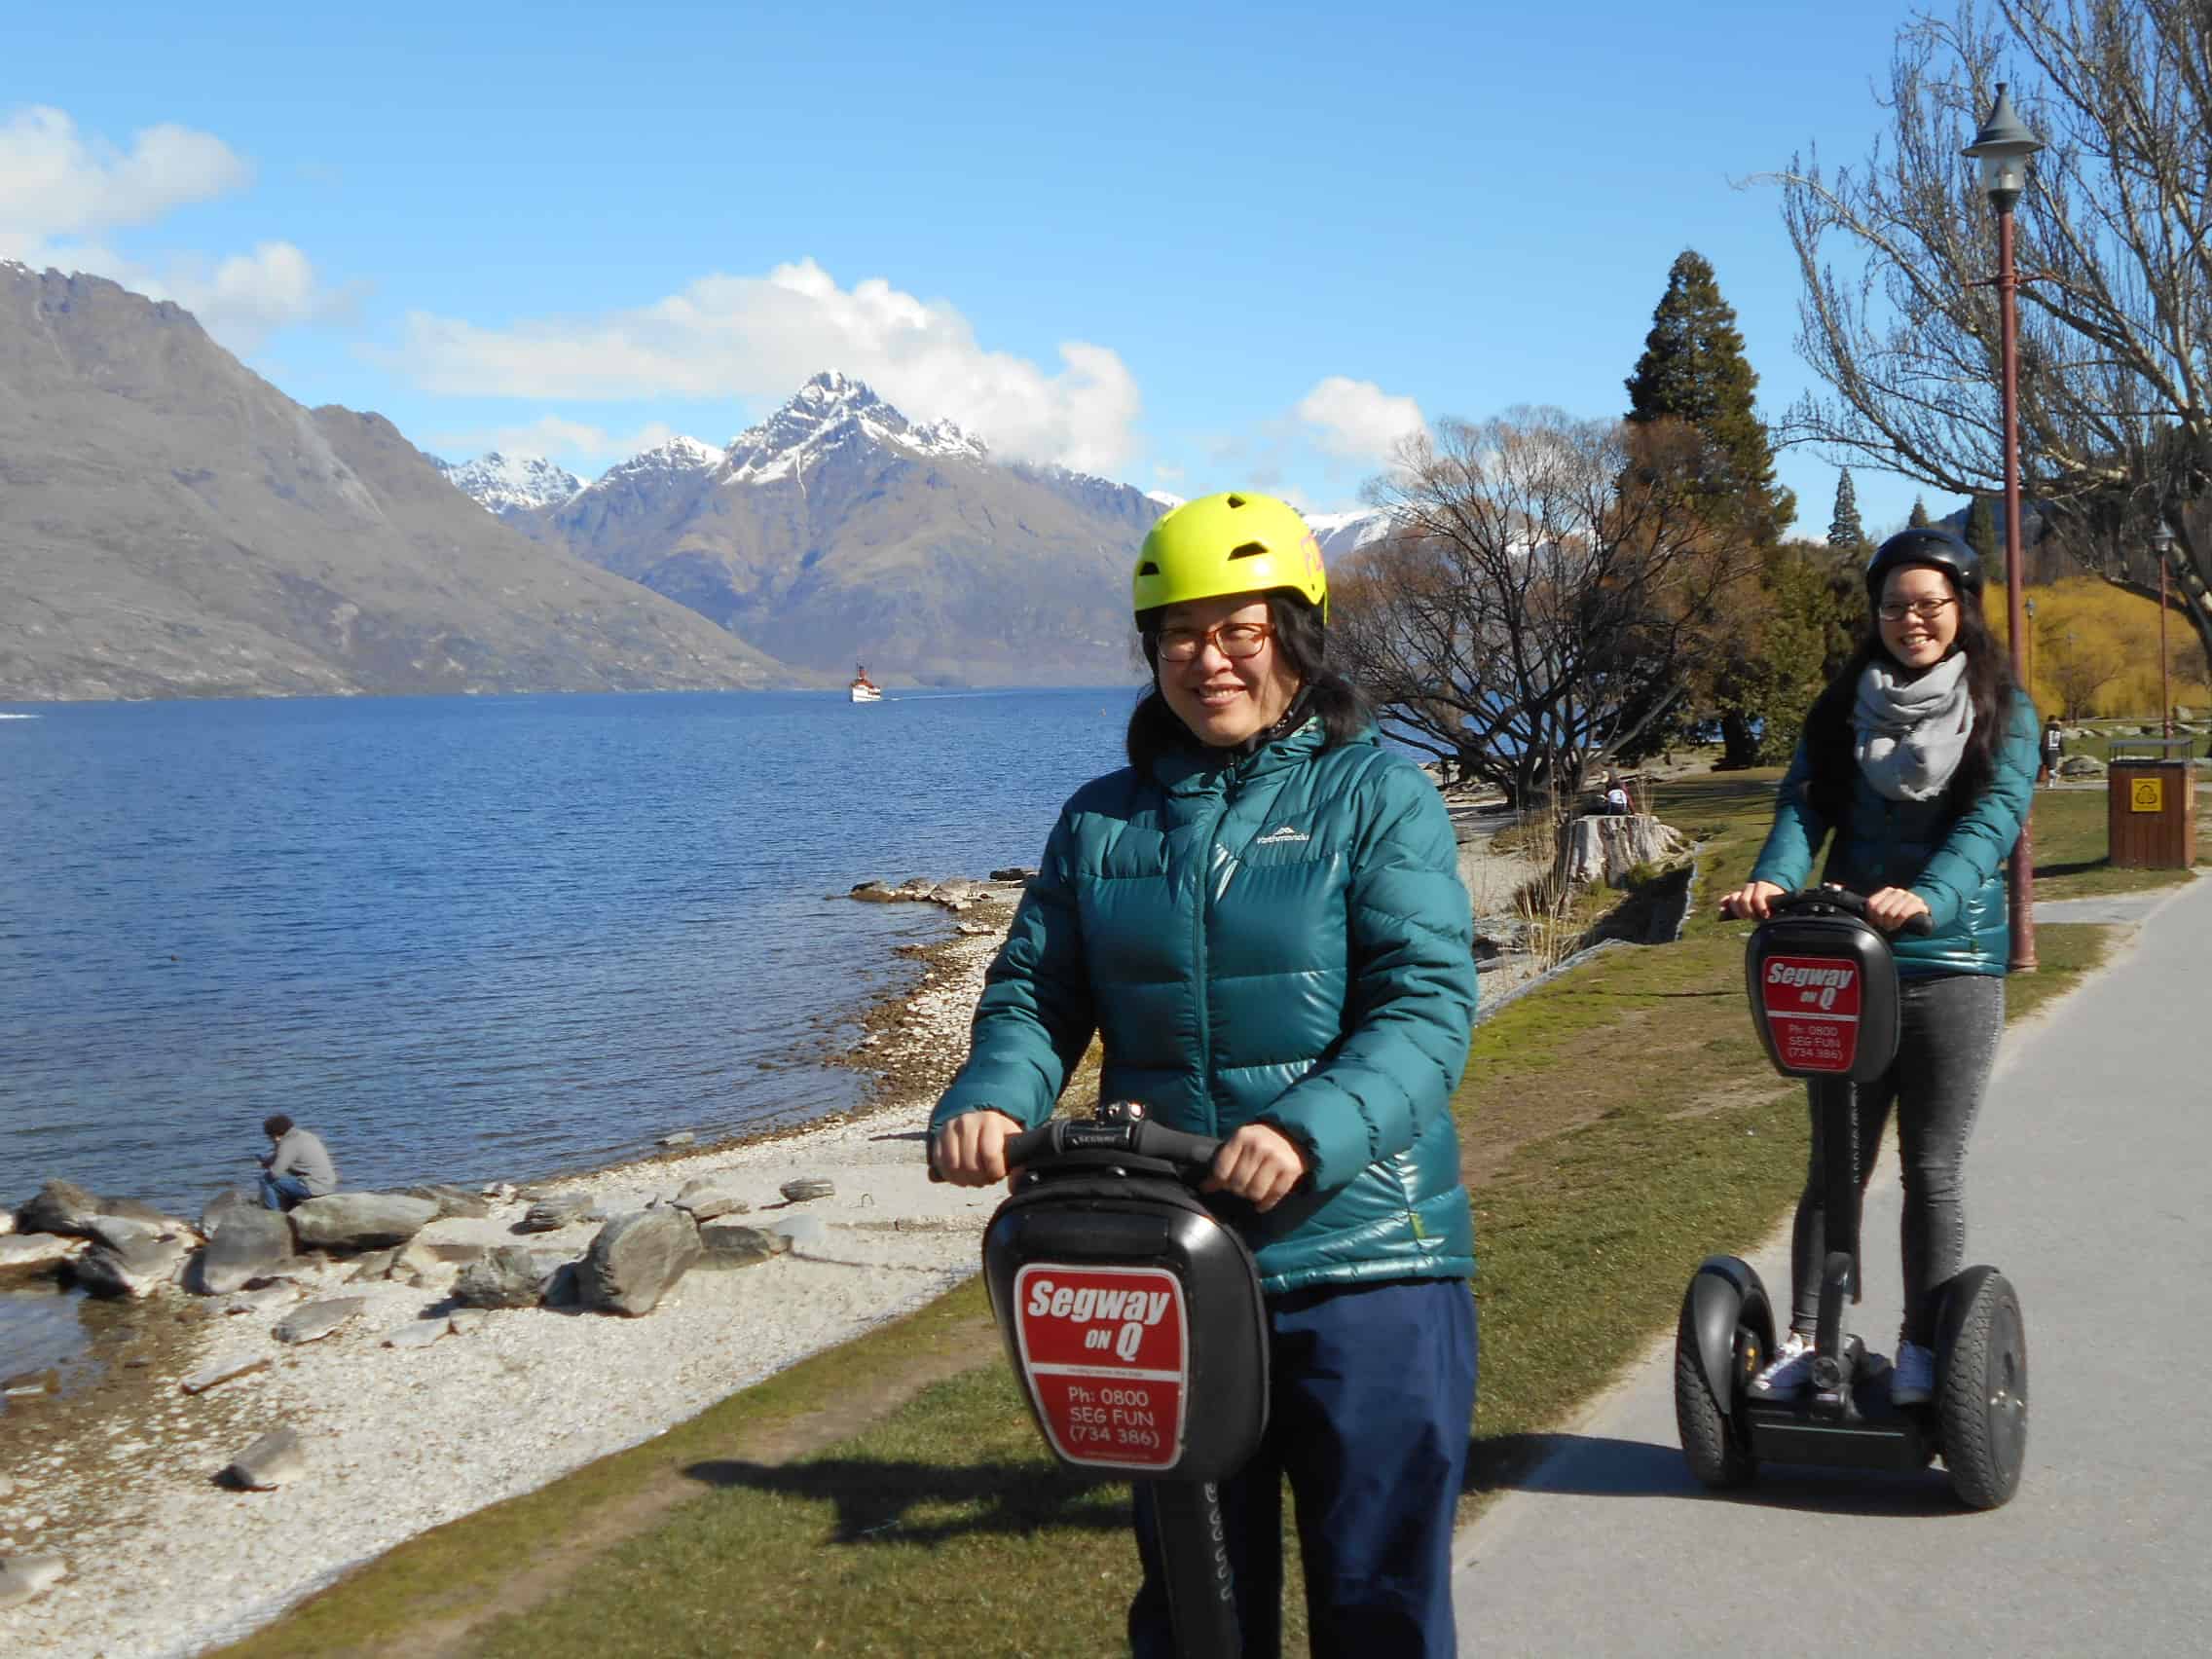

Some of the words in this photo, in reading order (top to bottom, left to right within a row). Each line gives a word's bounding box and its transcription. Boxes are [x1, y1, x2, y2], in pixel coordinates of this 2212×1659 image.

[1768, 962, 1854, 988] Segway
[1819, 987, 1836, 1010] Q
[1808, 1026, 1839, 1037] 0800
[1027, 1279, 1170, 1325] Segway
[1085, 1329, 1112, 1349] ON
[1116, 1322, 1143, 1361] Q
[1067, 1385, 1096, 1403] Ph:
[1100, 1388, 1150, 1407] 0800
[1070, 1407, 1107, 1423] SEG
[1113, 1409, 1154, 1426] FUN
[1070, 1424, 1111, 1442] (734
[1117, 1428, 1161, 1449] 386)
